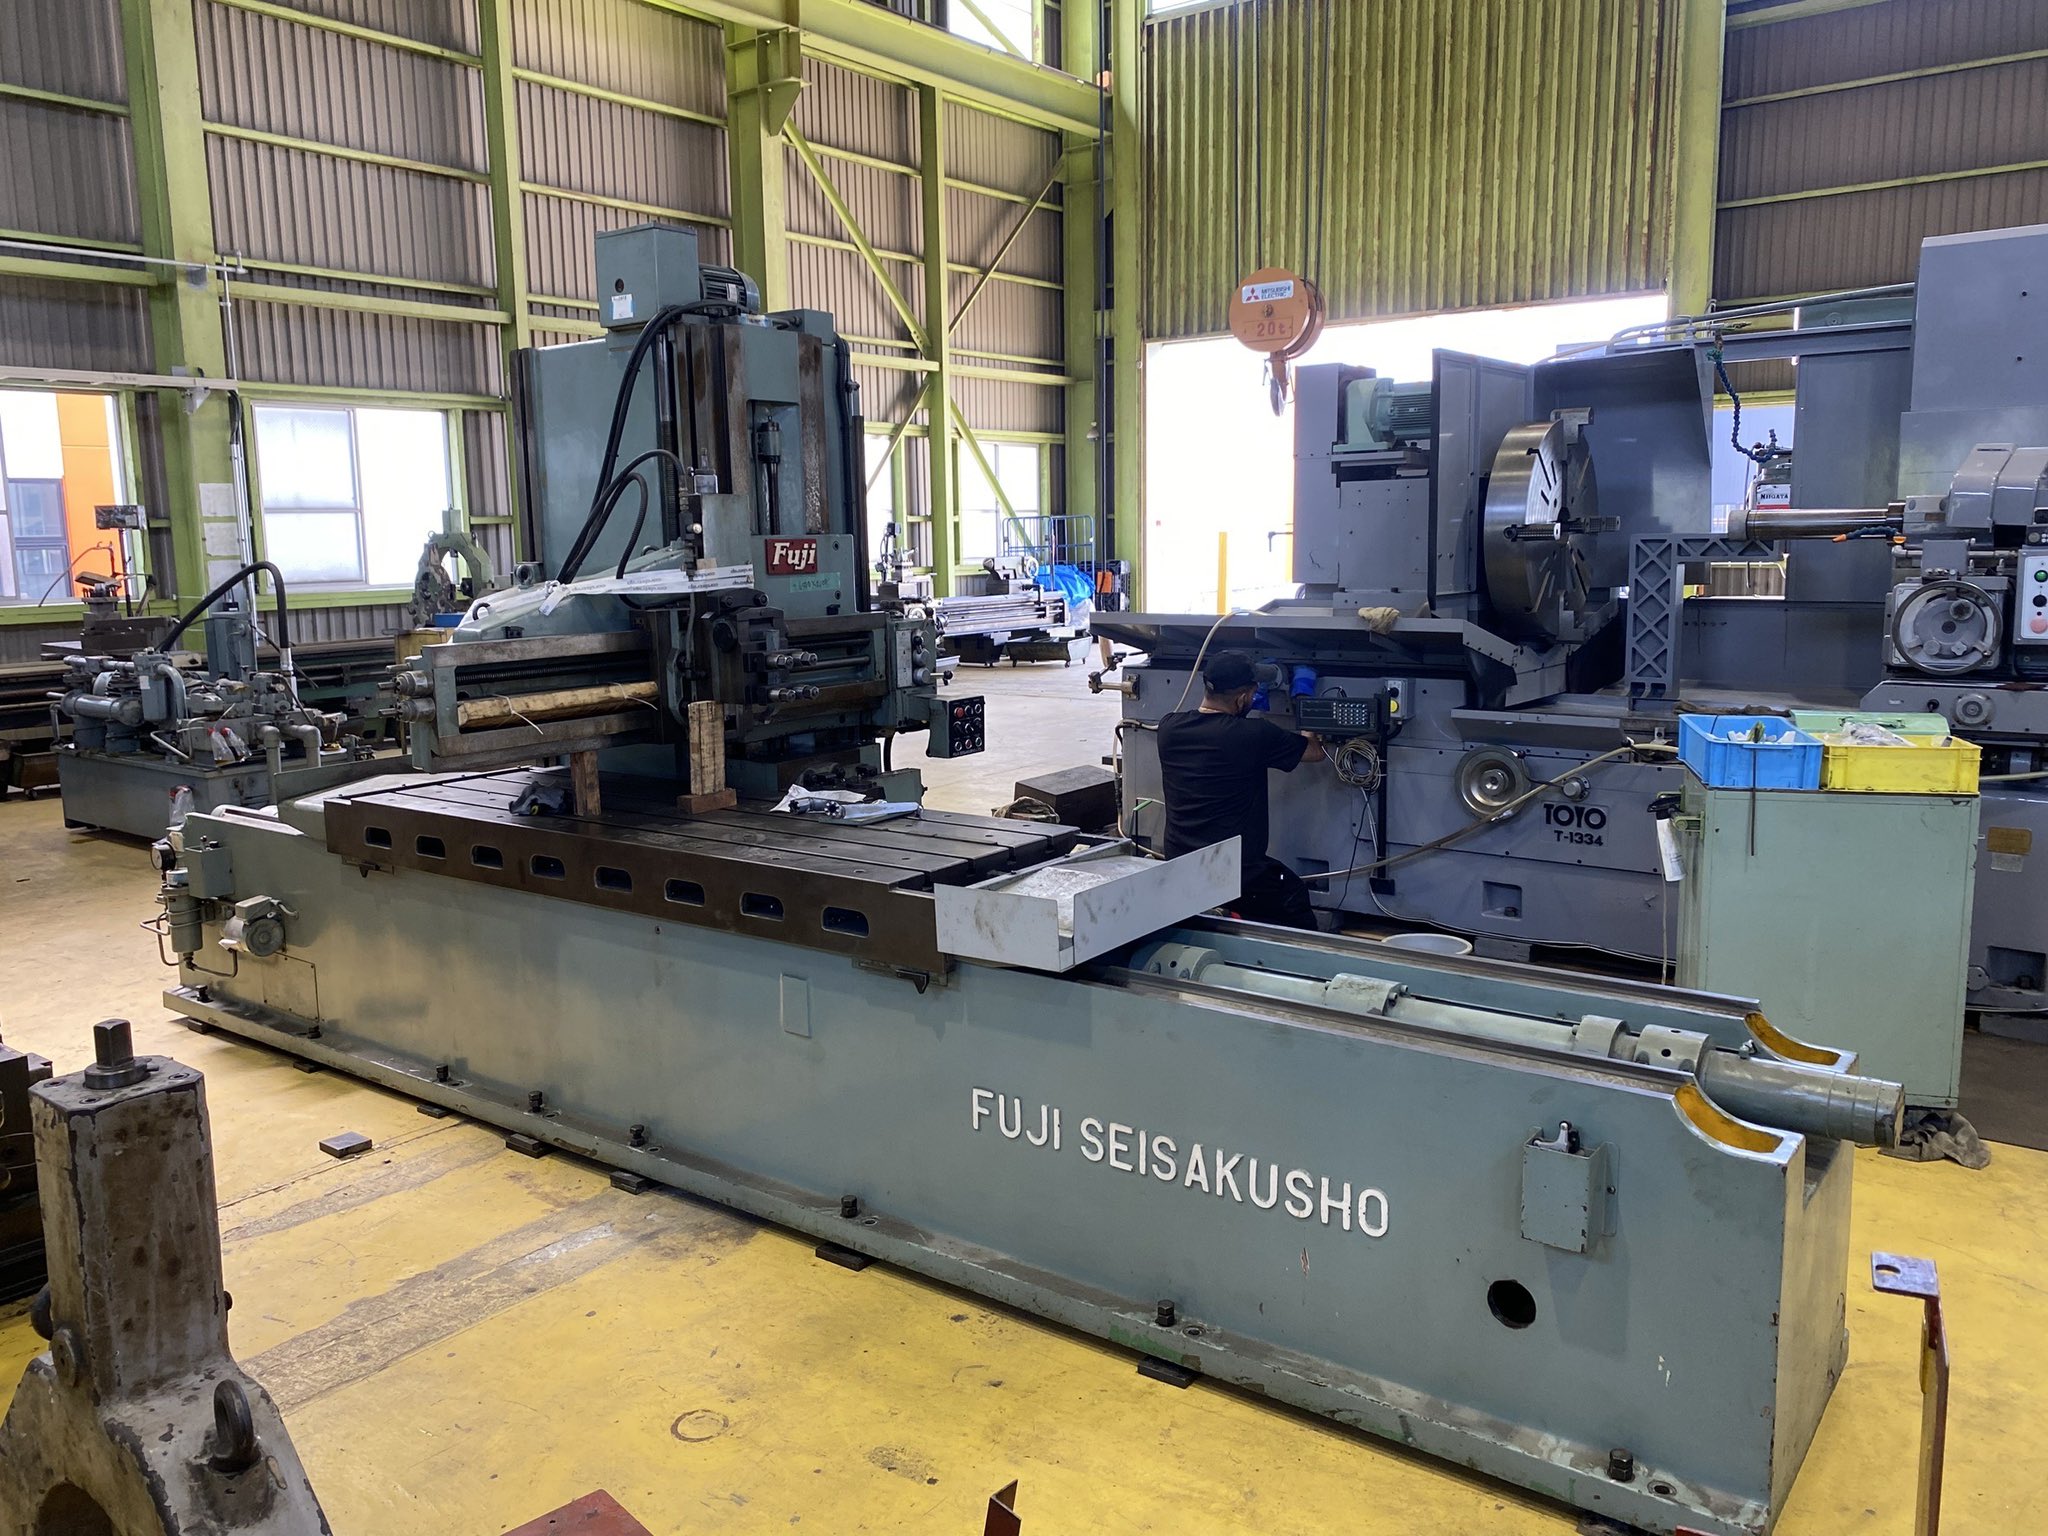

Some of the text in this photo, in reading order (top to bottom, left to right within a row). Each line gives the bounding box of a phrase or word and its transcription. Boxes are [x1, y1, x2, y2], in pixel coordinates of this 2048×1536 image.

[1261, 291, 1287, 299] ELECTRIC
[772, 542, 817, 570] Fuji
[1543, 803, 1607, 830] TOYO
[1554, 829, 1604, 847] T-1334
[972, 1087, 1391, 1239] FUJI SEISAKUSHO
